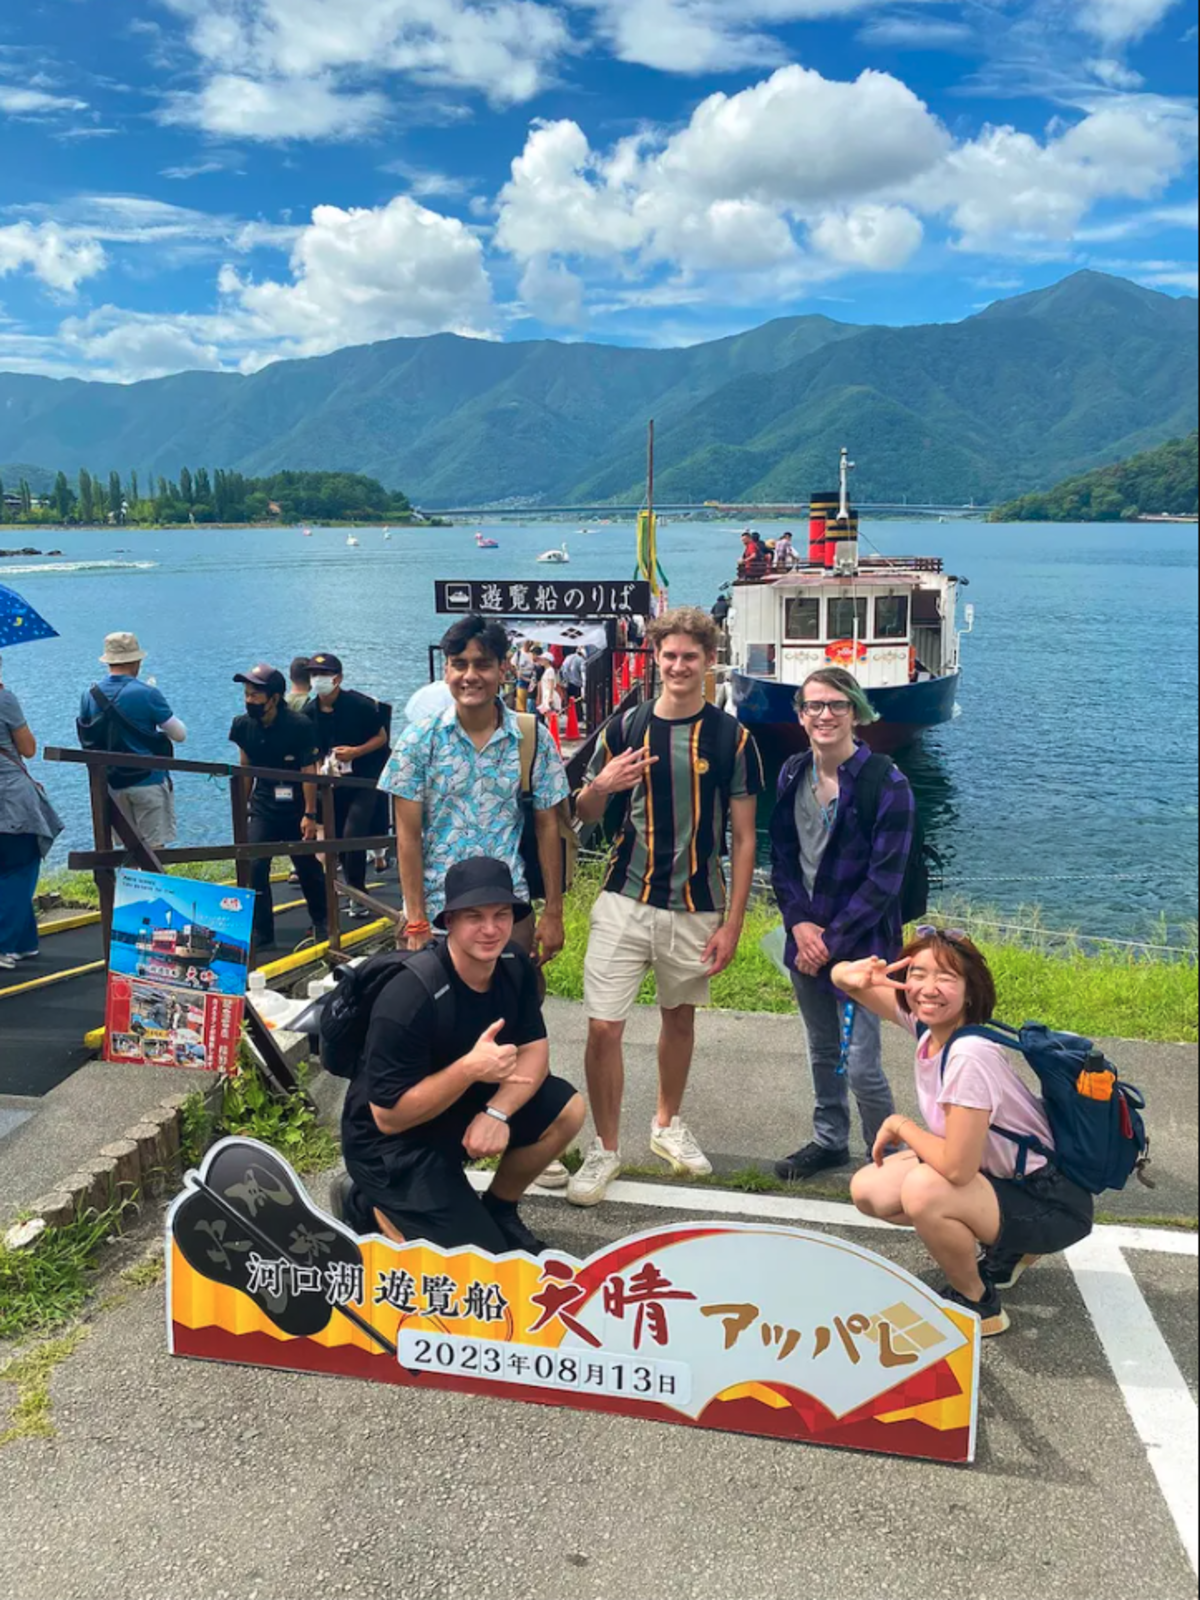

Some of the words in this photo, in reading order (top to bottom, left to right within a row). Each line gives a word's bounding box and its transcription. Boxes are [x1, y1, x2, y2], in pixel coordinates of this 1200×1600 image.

[479, 583, 636, 612] 遊覧船のりば
[246, 1253, 364, 1306] 河口湖
[374, 1270, 508, 1322] 遊覧船
[528, 1259, 698, 1350] 天晴
[414, 1339, 676, 1395] 2023年08月13日
